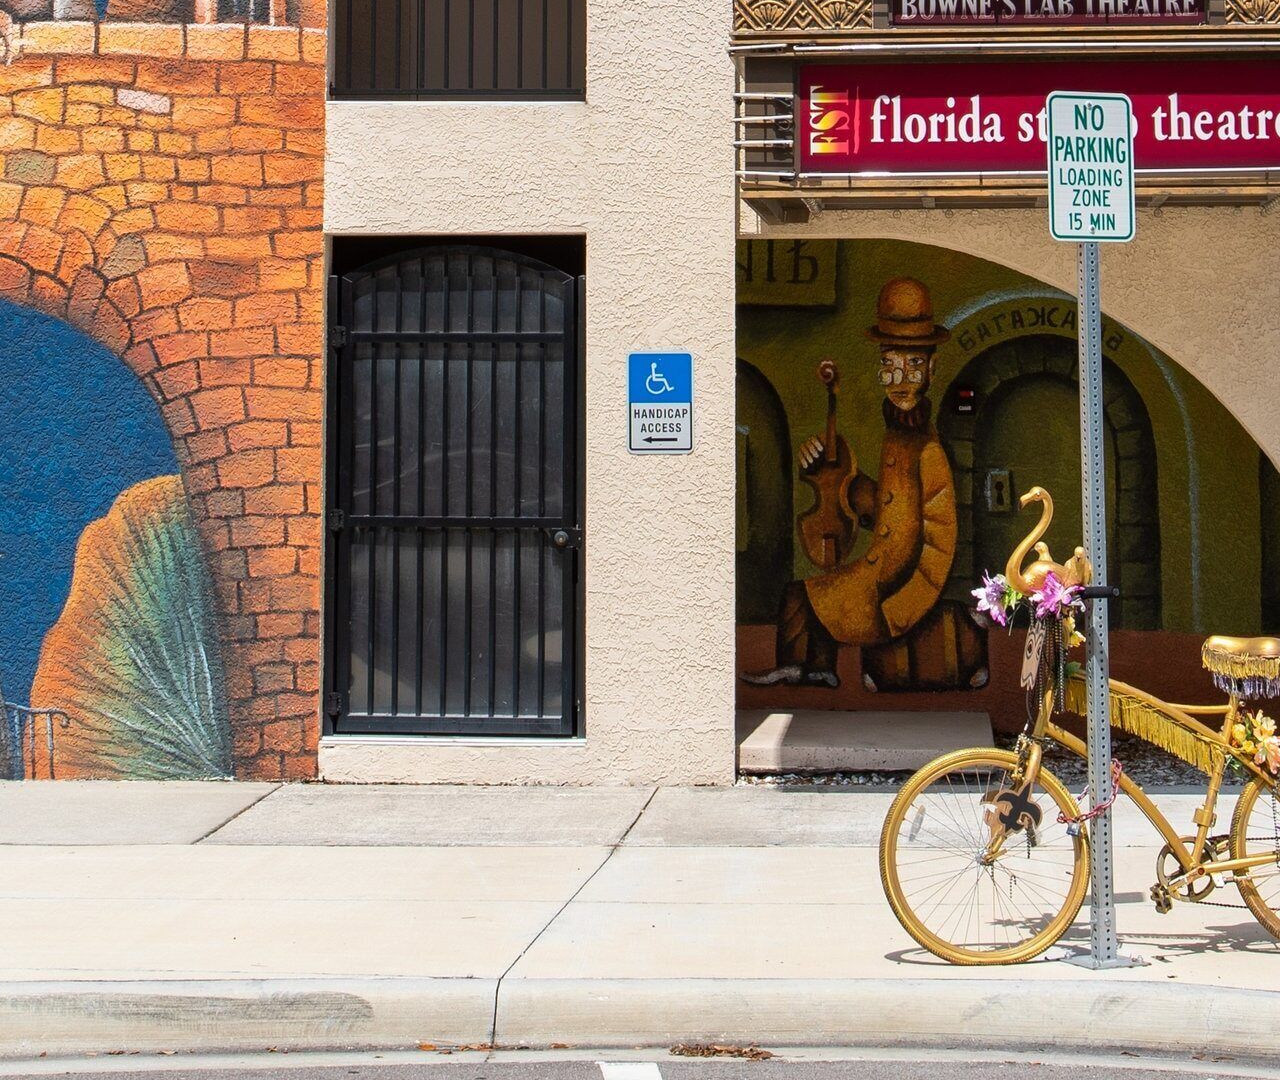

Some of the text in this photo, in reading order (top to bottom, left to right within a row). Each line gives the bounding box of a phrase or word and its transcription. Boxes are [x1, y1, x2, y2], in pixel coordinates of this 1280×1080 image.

[809, 84, 851, 156] FST
[870, 93, 1006, 144] florida
[1074, 103, 1105, 132] NO
[1054, 135, 1127, 164] PARKING
[1059, 167, 1124, 188] LOADING
[1072, 188, 1112, 208] ZONE
[1068, 212, 1116, 232] 15 MIN
[633, 408, 688, 419] HANDICAP
[640, 422, 682, 433] ACCESS
